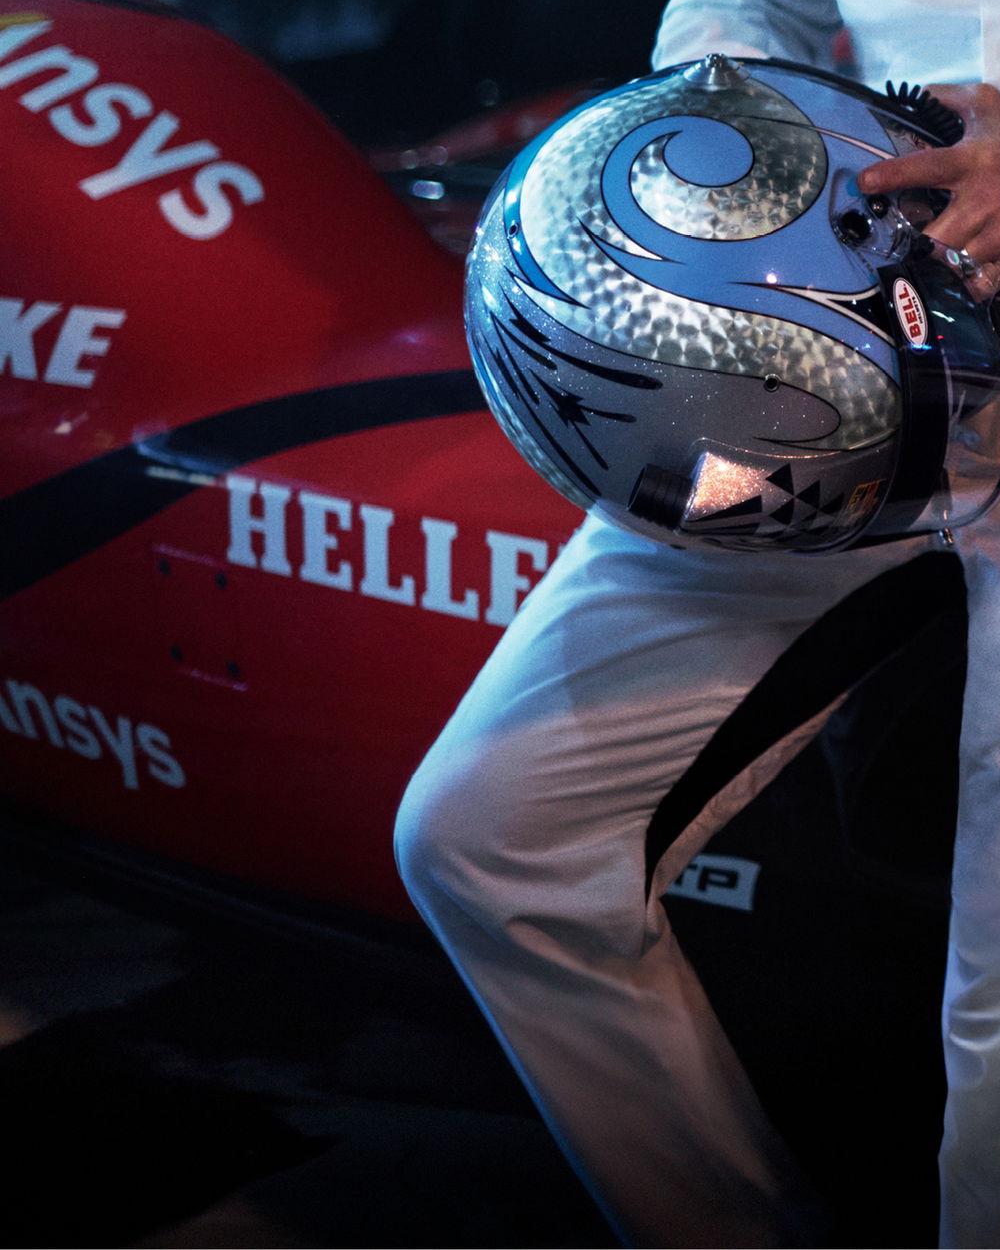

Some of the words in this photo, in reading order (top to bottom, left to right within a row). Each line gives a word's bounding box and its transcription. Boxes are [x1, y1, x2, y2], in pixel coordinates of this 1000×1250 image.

[898, 286, 922, 339] BELL
[225, 473, 567, 629] HELLE
[0, 678, 187, 791] nsys
